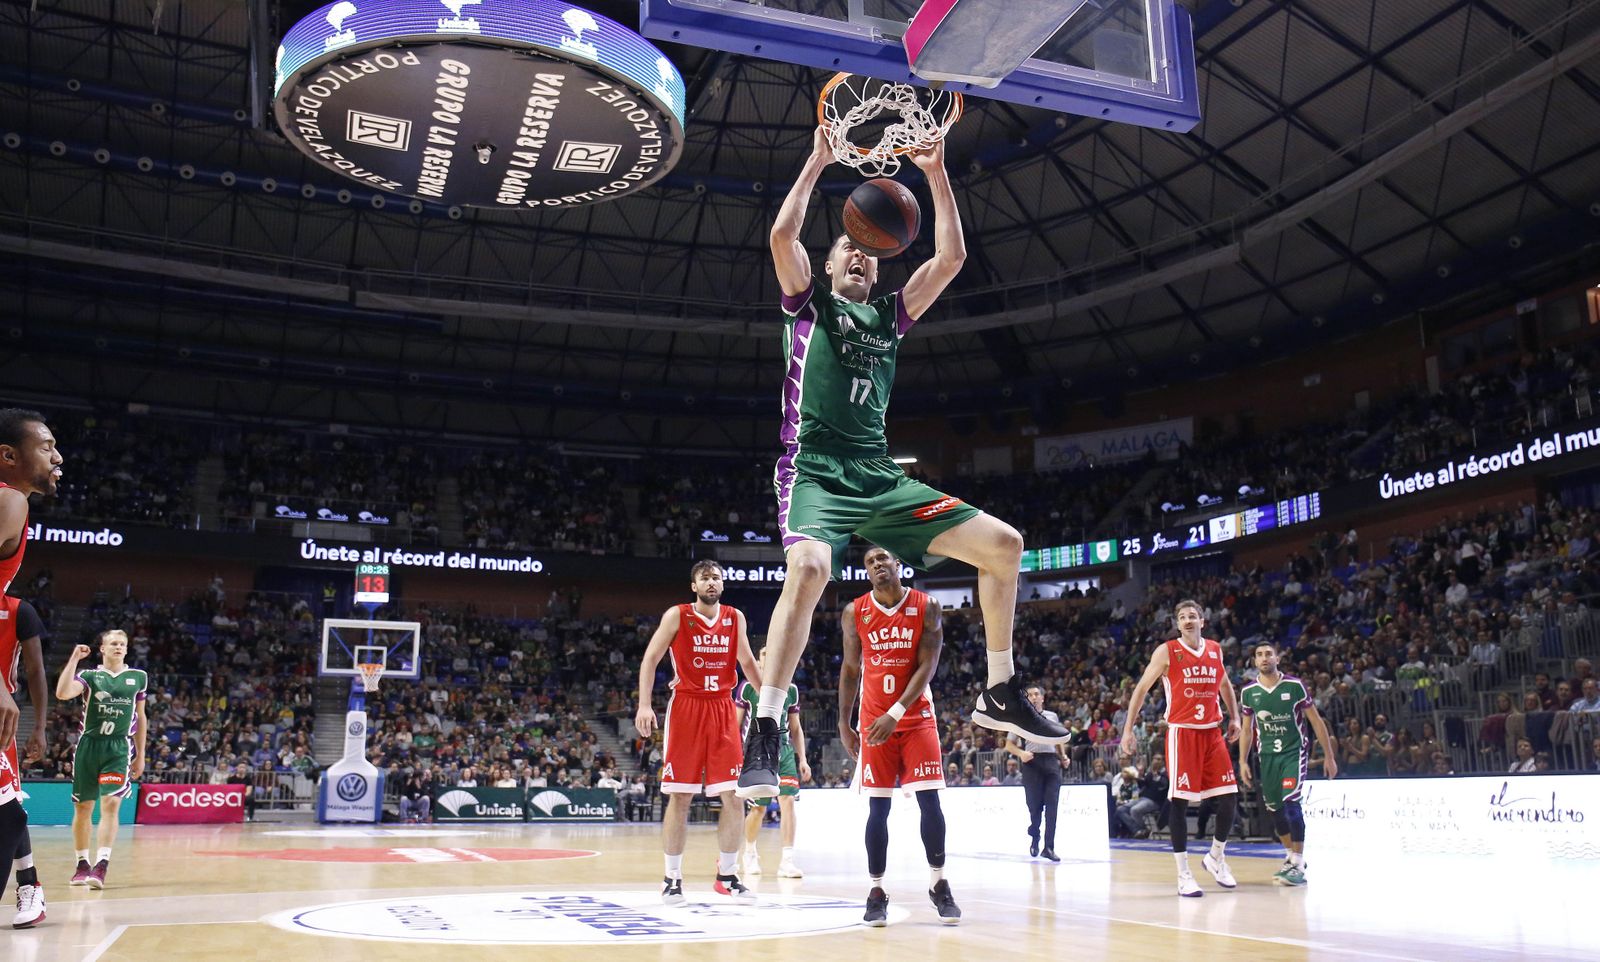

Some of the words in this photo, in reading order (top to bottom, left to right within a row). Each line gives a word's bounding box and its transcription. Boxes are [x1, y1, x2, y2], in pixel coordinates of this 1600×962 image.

[307, 51, 421, 98] PORTICO
[432, 59, 471, 124] GRUPO
[516, 73, 565, 149] RESERVA
[427, 126, 458, 146] LA
[509, 151, 540, 168] LA
[417, 146, 453, 198] RESERVA
[496, 169, 532, 205] GRUPO
[526, 180, 630, 207] PORTICO
[850, 377, 872, 405] 17
[1379, 473, 1435, 499] Únete
[1437, 462, 1454, 485] al
[1458, 443, 1524, 480] récord
[1528, 433, 1562, 462] del
[46, 527, 123, 547] mundo
[1189, 525, 1205, 543] 21
[300, 538, 359, 563] Únete
[363, 547, 380, 563] al
[383, 549, 444, 568] récord
[448, 553, 476, 569] del
[479, 556, 543, 573] mundo
[1122, 538, 1141, 556] 25
[748, 566, 764, 581] al
[362, 576, 385, 593] 13
[693, 634, 730, 647] UCAM
[868, 626, 914, 644] UCAM
[693, 645, 729, 653] UNIVERSIDAD
[871, 641, 912, 650] UNIVERSIDAD
[1182, 665, 1217, 678] UCAM
[704, 675, 720, 692] 15
[883, 674, 895, 694] 0
[1194, 703, 1205, 720] 3
[99, 720, 115, 736] 10
[1273, 738, 1283, 752] 3
[145, 788, 242, 808] endesa
[475, 803, 523, 817] Unicaja
[567, 803, 613, 817] Unicaja
[1488, 792, 1584, 824] merendero
